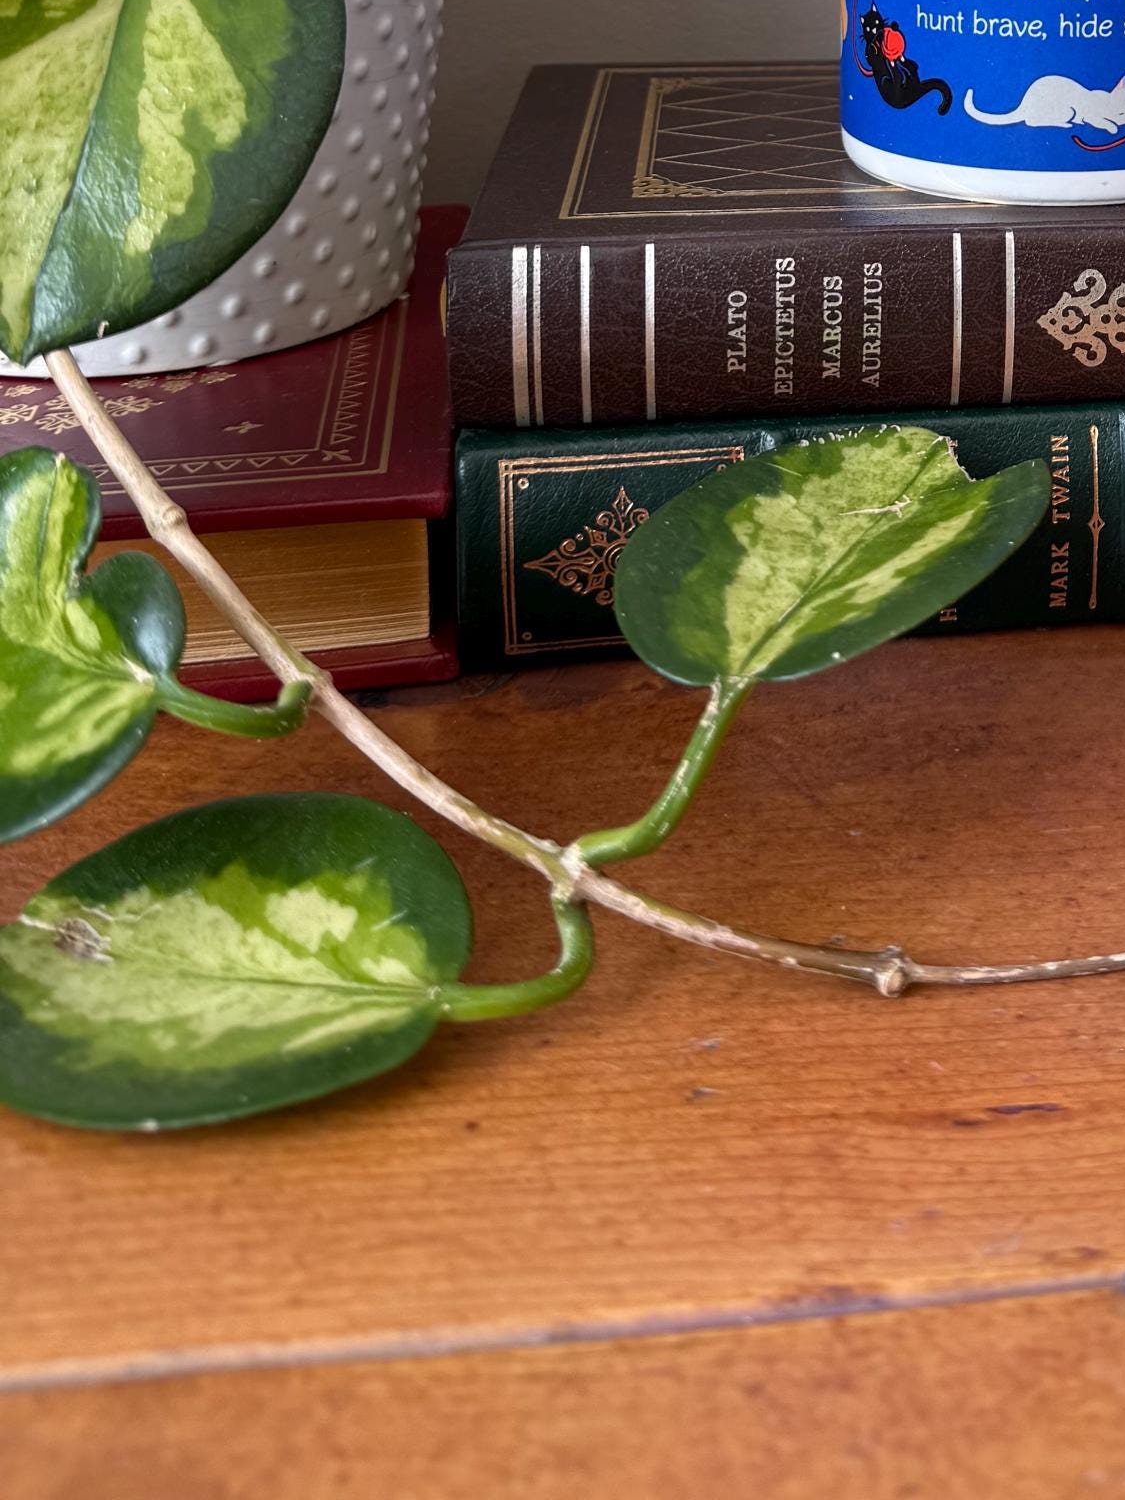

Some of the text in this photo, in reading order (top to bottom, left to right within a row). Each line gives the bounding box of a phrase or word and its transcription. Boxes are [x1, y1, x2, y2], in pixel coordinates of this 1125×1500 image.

[916, 4, 964, 34] hunt
[973, 10, 1047, 41] brave,
[1059, 13, 1113, 38] hide
[726, 290, 748, 373] PLATO
[769, 256, 796, 395] EPICTETUS
[822, 275, 843, 379] MARCUS
[861, 261, 883, 388] AURELIUS
[1048, 434, 1071, 608] MARK TWAIN
